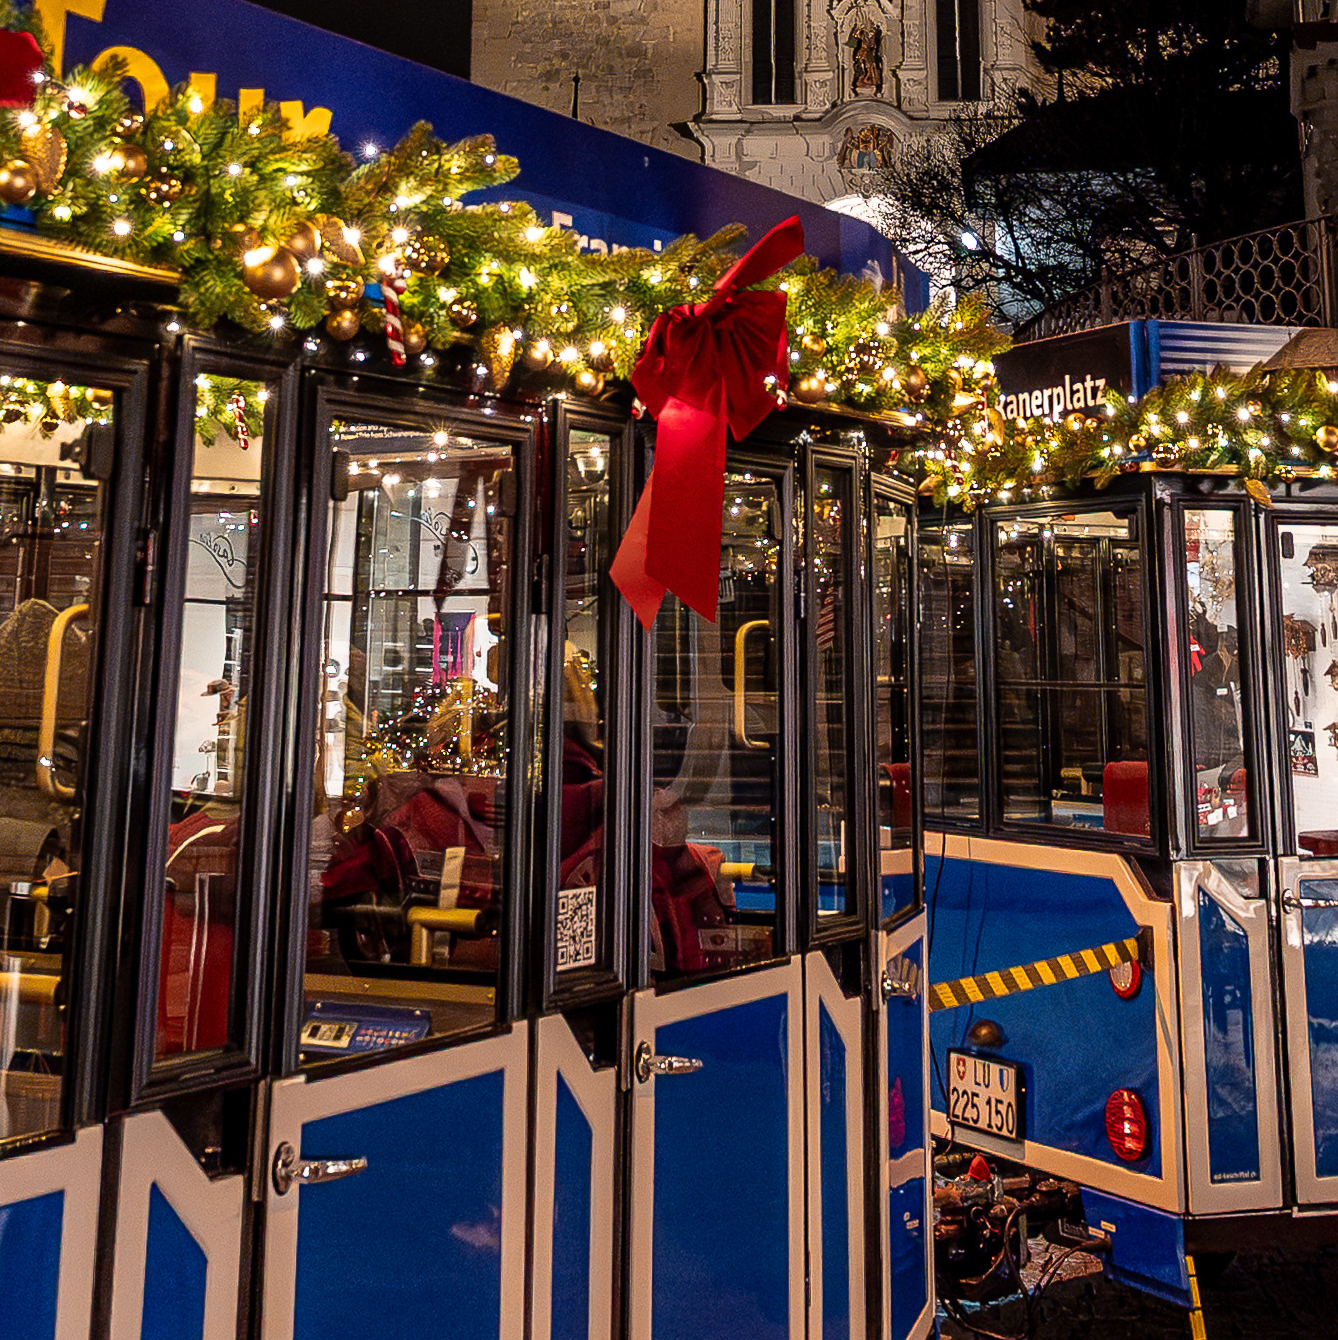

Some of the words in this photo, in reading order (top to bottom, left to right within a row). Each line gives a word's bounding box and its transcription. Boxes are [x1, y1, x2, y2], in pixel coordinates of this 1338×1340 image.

[973, 1059, 991, 1089] LU
[951, 1086, 981, 1125] 225
[985, 1095, 1016, 1135] 150
